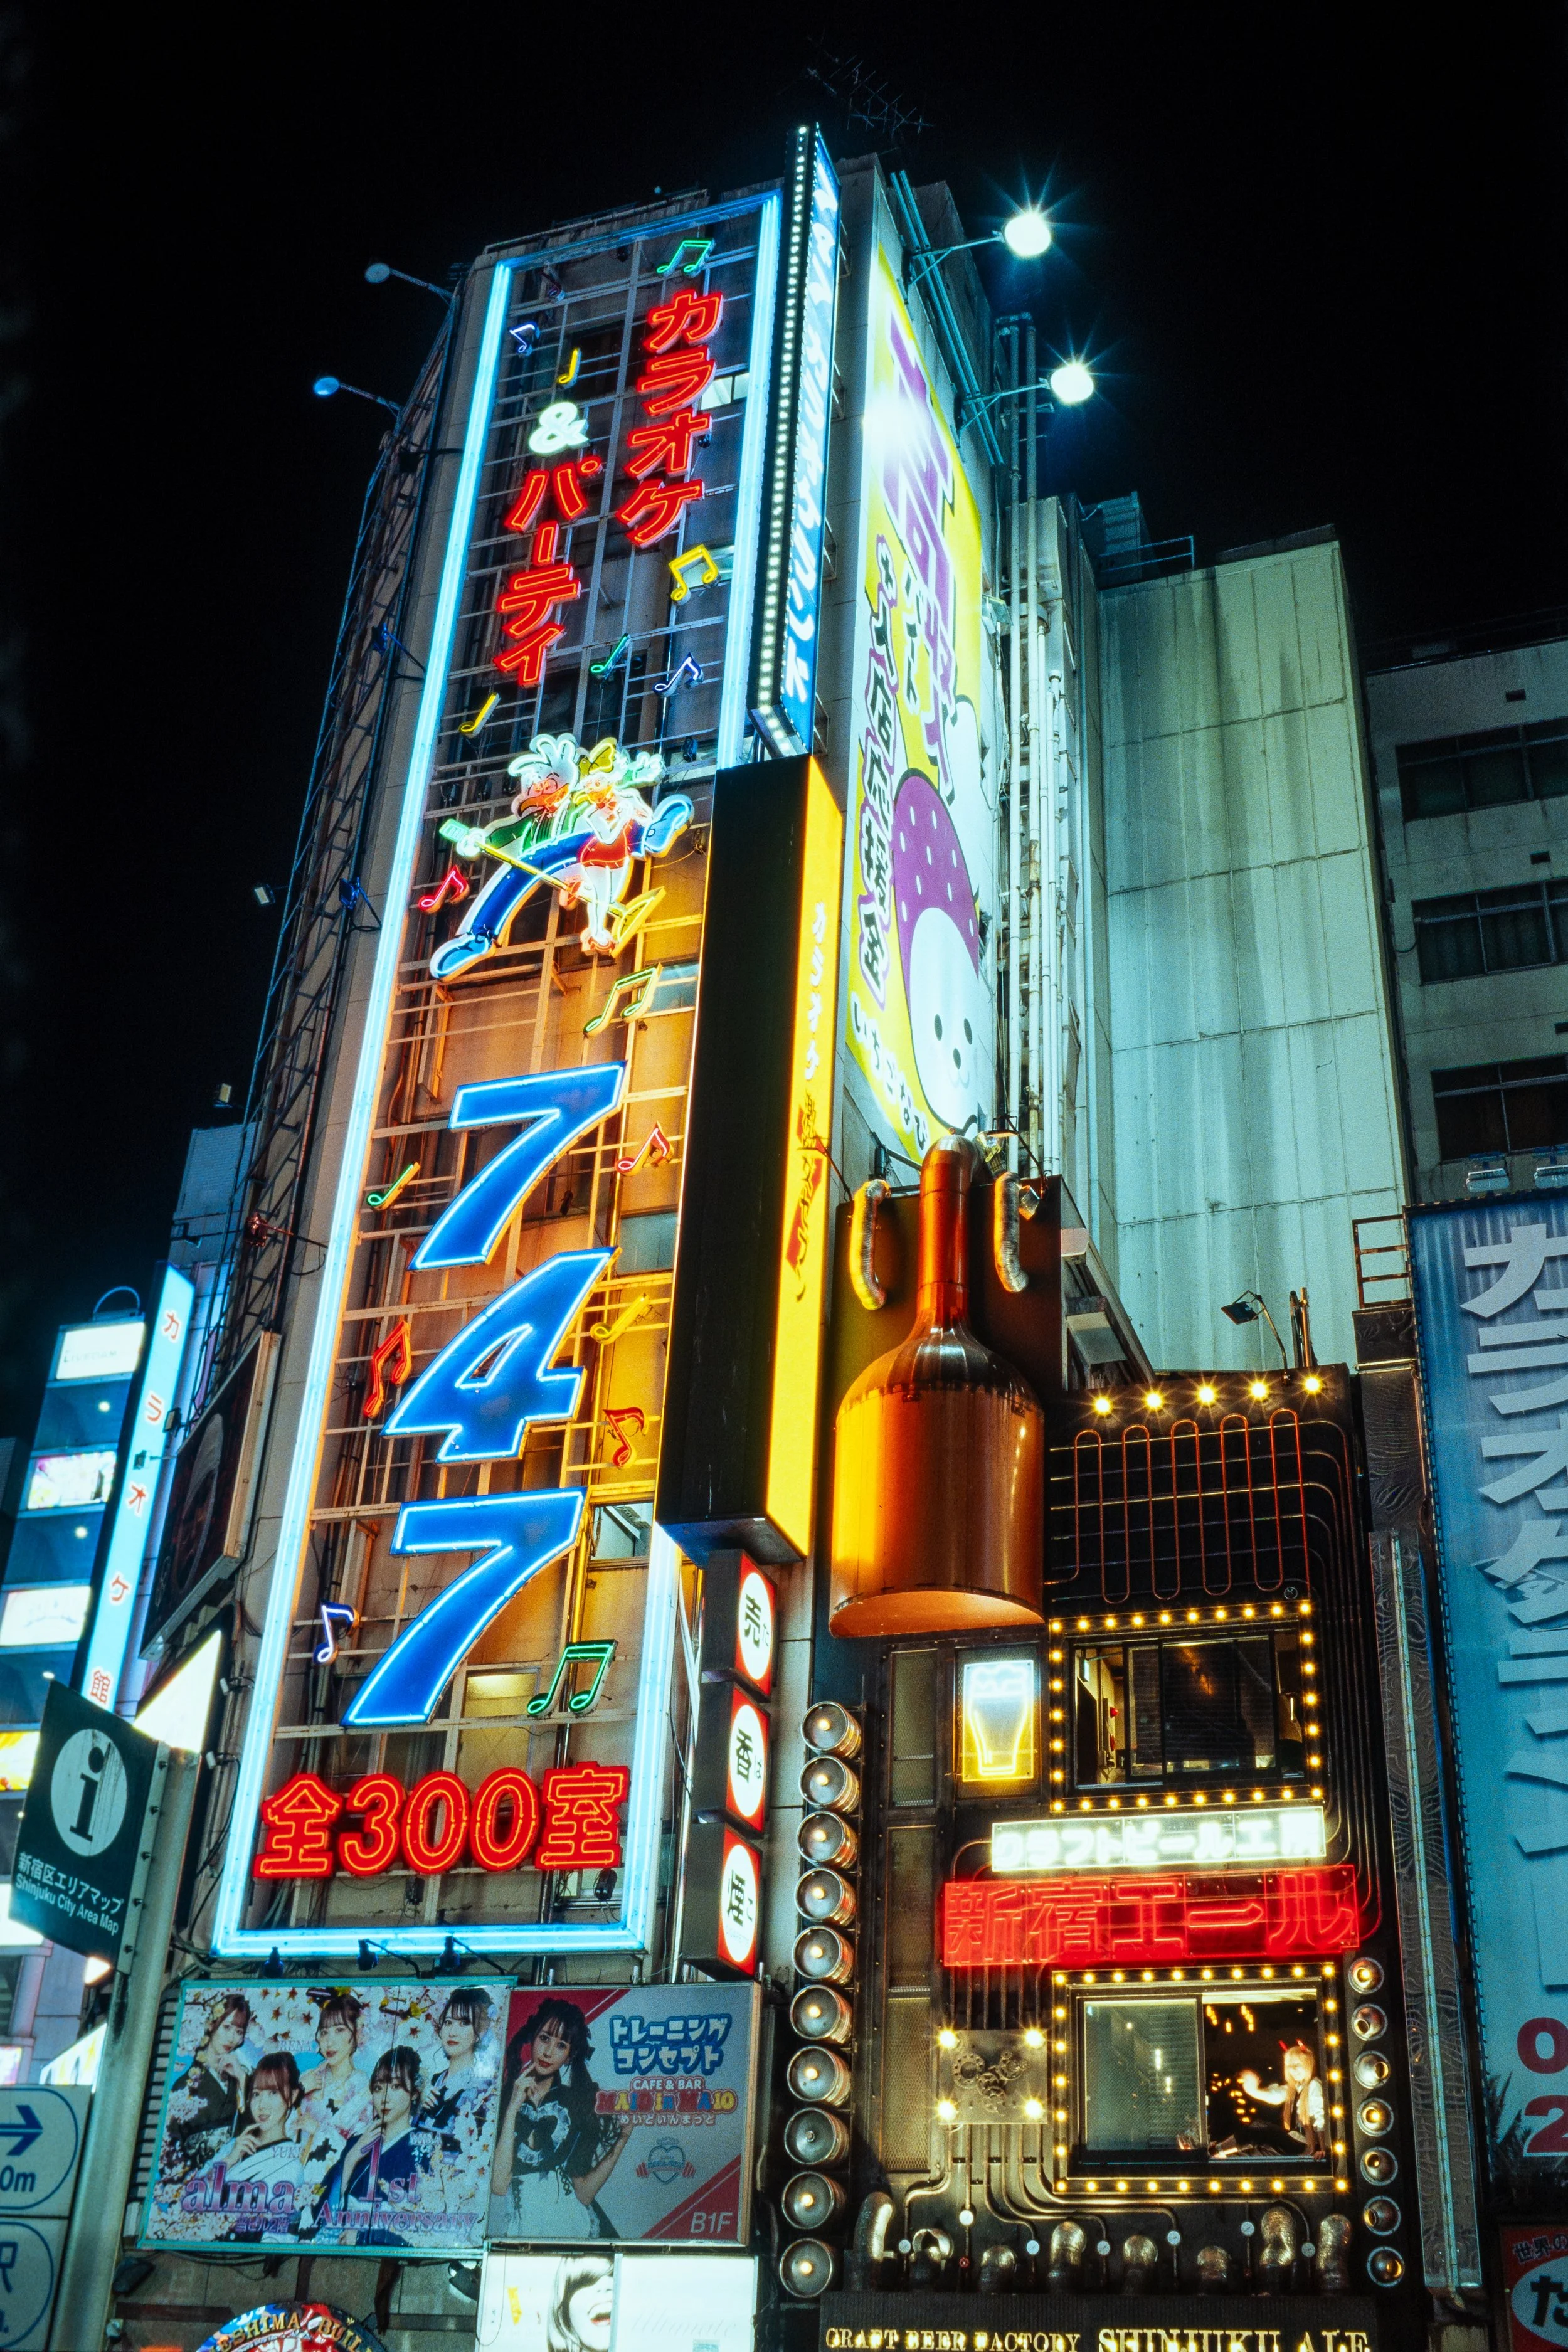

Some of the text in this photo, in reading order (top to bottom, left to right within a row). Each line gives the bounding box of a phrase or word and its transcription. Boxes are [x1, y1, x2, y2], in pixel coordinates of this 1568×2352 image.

[615, 289, 724, 548] カラオケ
[342, 1062, 625, 1726] 747
[90, 1310, 182, 1711] カラオケ館
[254, 1761, 630, 1880] 全300室
[16, 1873, 120, 1937] Shinjuku City Area Map
[17, 1851, 125, 1915] 新宿区エリアマップ
[945, 1870, 1355, 1963] 新宿エール
[611, 2015, 729, 2045] トレーニング
[615, 2045, 721, 2072] コンセプト
[633, 2078, 702, 2090] CAFE & BAR
[654, 2091, 675, 2111] in
[181, 2161, 296, 2214] alma
[312, 2200, 478, 2243] Anniversary
[689, 2212, 734, 2233] B1F
[825, 2328, 1081, 2352] CRAFT BEER FACTORY
[1098, 2328, 1370, 2352] SHINJUKU ALE
